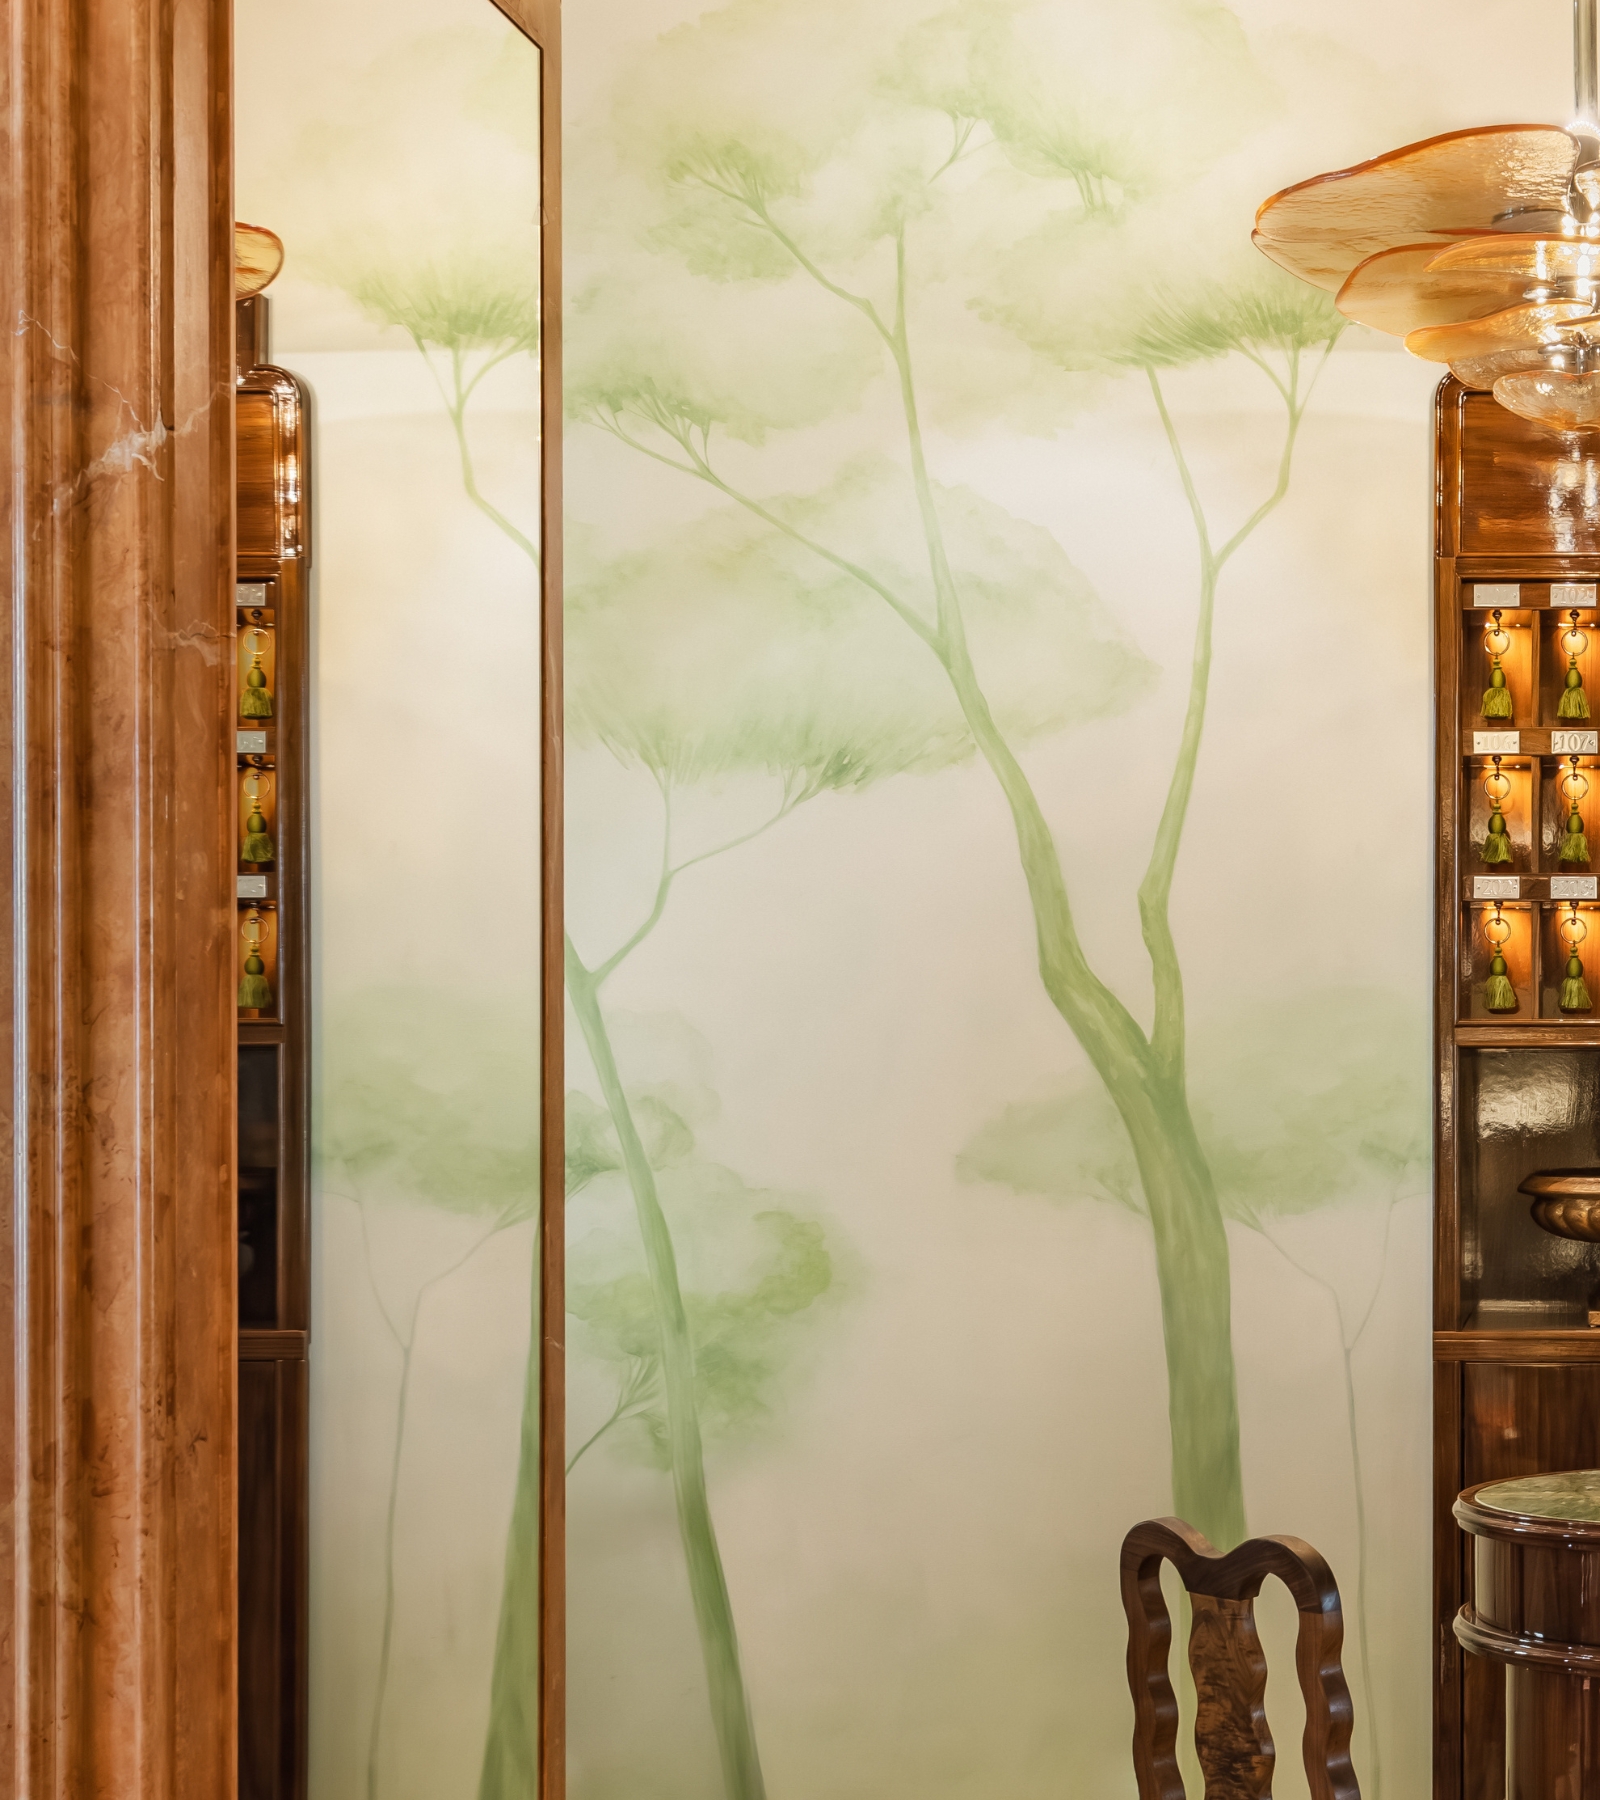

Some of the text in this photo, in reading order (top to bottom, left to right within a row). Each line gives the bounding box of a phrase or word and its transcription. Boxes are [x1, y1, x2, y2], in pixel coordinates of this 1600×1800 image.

[1560, 588, 1587, 604] 102
[1481, 734, 1511, 750] 106
[1559, 734, 1590, 750] 107
[1482, 879, 1512, 895] 202
